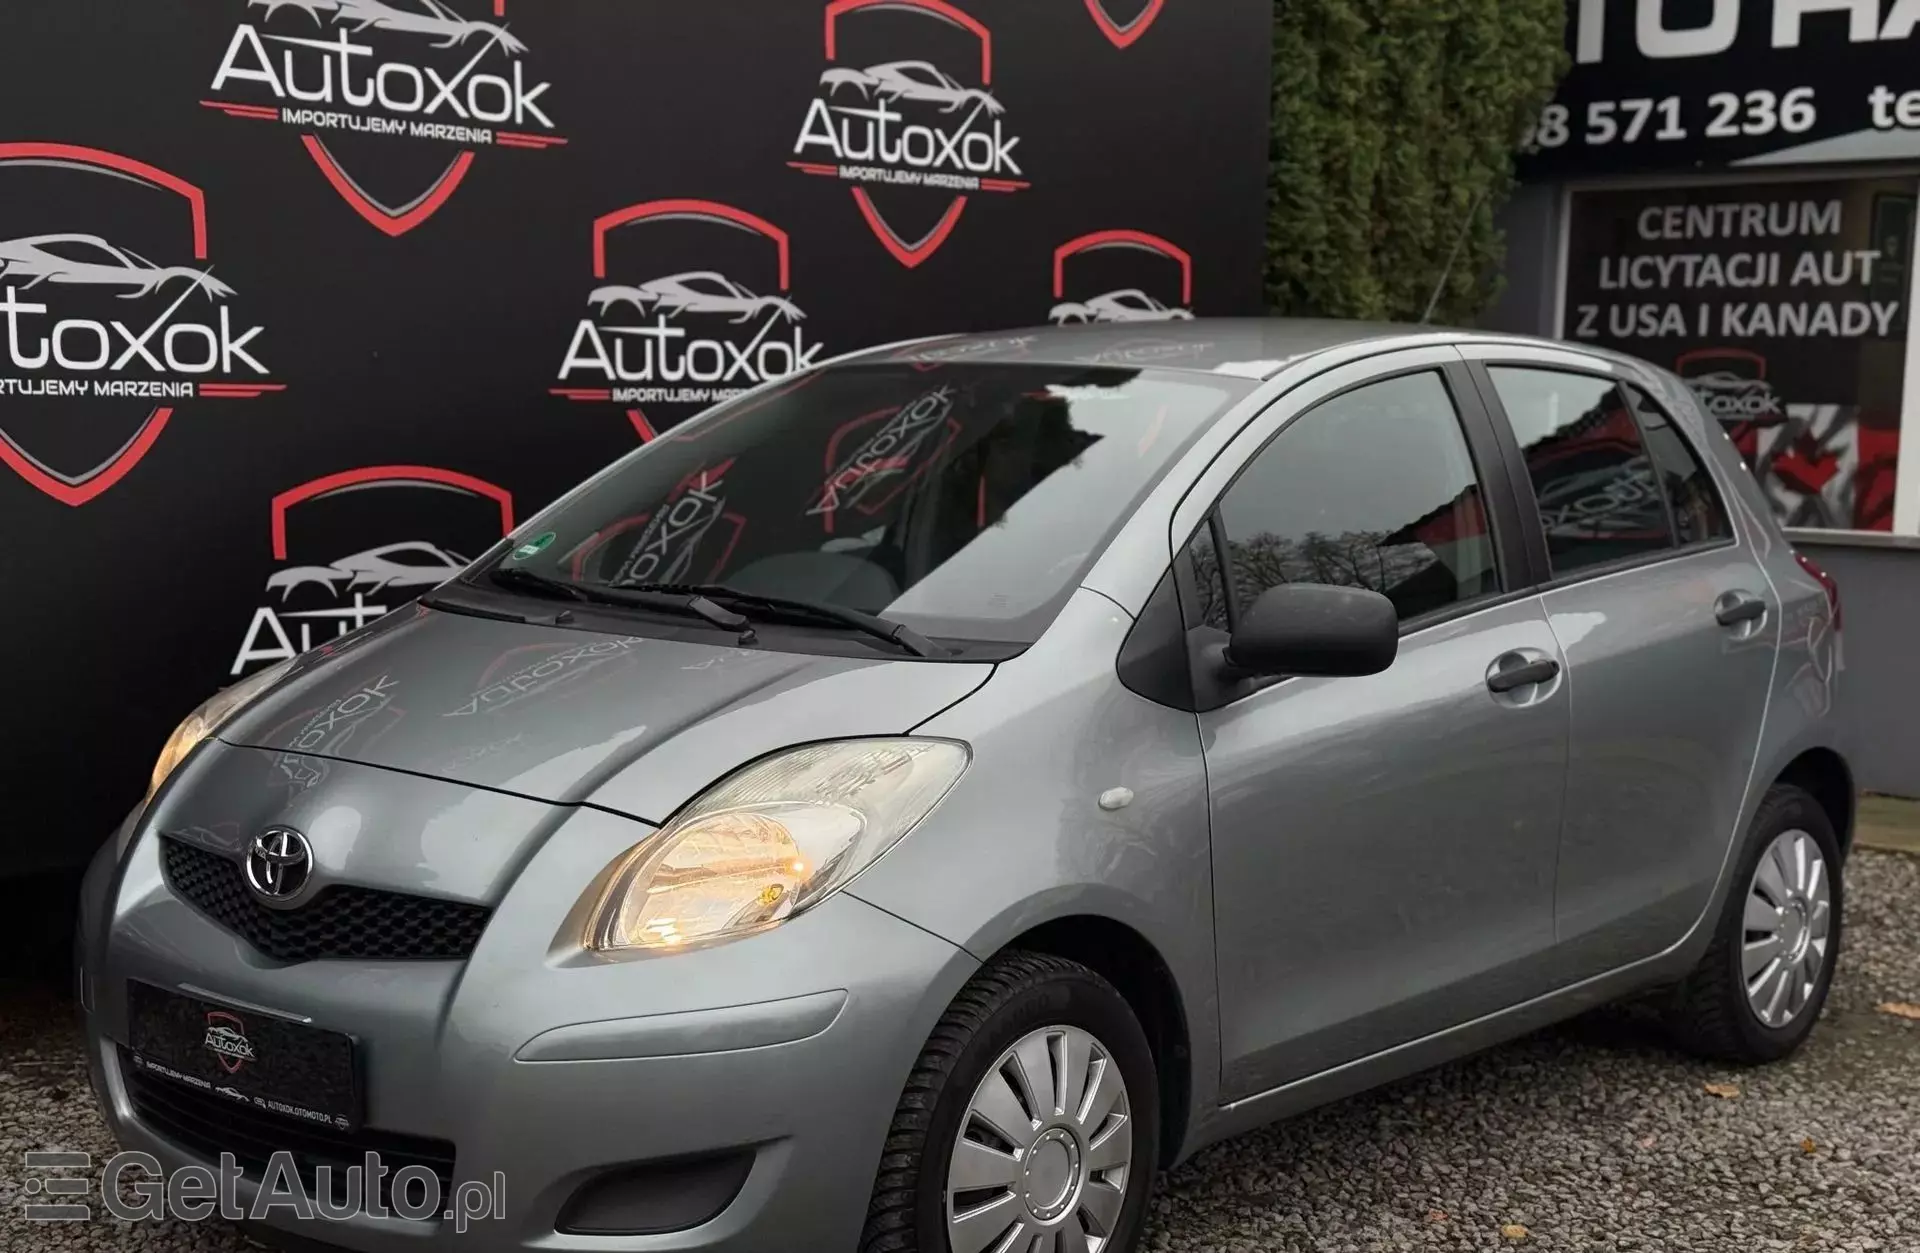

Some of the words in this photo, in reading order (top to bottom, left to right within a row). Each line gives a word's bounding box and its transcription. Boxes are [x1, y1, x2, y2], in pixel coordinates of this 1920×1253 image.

[211, 23, 555, 128] Autoxok
[282, 107, 407, 136] IMPORTUJEMY
[410, 122, 493, 144] MARZENIA
[794, 97, 1022, 175] Autoxok
[1522, 103, 1571, 148] 8
[1584, 96, 1687, 144] 571
[1705, 87, 1817, 138] 236
[838, 164, 922, 185] IMPORTUJEMY
[922, 173, 980, 190] MARZENIA
[1637, 200, 1842, 240] CENTRUM
[1599, 253, 1780, 289] LICYTACJI
[1789, 250, 1881, 286] AUT
[1576, 305, 1599, 338] Z
[1609, 303, 1688, 338] USA
[1697, 304, 1710, 335] I
[1720, 301, 1900, 337] KANADY
[557, 311, 824, 382] Autoxok
[0, 378, 89, 396] TUJEMY
[93, 380, 194, 398] MARZENIA
[611, 386, 711, 403] IMPORTUJEMY
[204, 1033, 255, 1058] Autoxok
